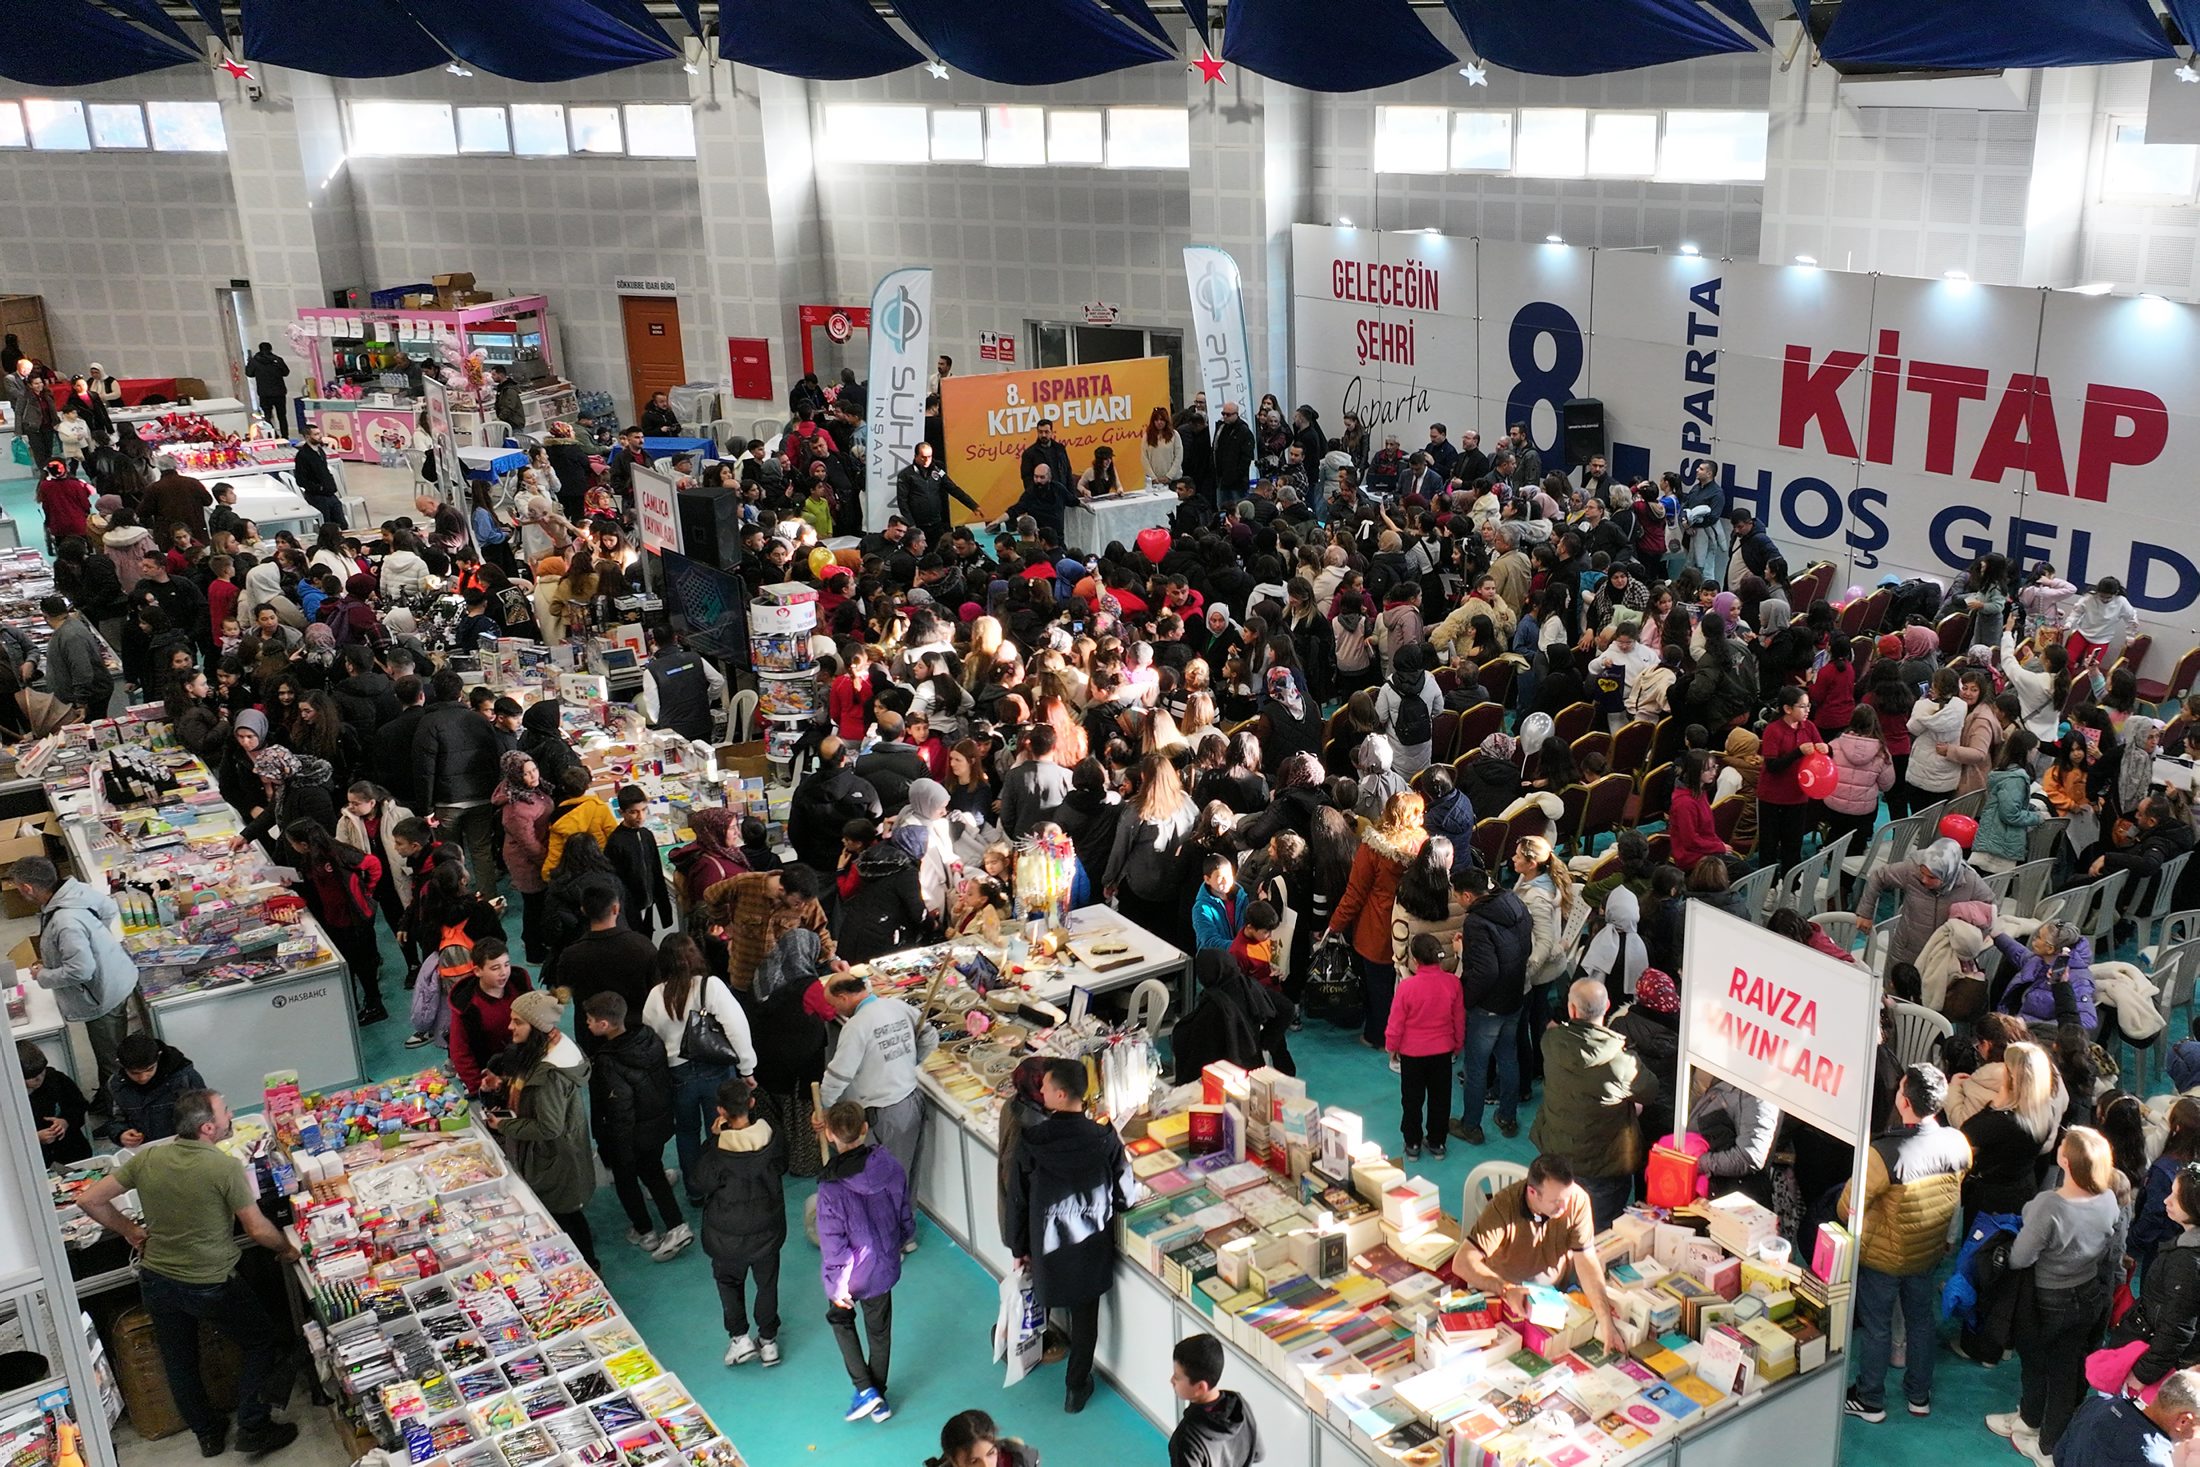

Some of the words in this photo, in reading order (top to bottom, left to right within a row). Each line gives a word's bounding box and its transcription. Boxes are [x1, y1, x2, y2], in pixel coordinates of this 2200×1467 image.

[645, 280, 660, 290] İDARİ
[660, 282, 675, 291] BÜRO
[1332, 258, 1439, 311] GELECEĞİN
[1356, 318, 1415, 366] ŞEHRİ
[1006, 383, 1026, 407] 8.
[1032, 374, 1113, 403] ISPARTA
[1680, 277, 1723, 487] SPARTA
[870, 397, 886, 479] İNŞAAT
[987, 403, 1061, 437] KİTAP
[1063, 394, 1133, 428] FUARI
[1778, 328, 2169, 503] KİTAP
[643, 491, 670, 519] ÇAMLICA
[643, 514, 675, 545] YAYINLARI
[1720, 463, 1889, 570] HOŞ
[1728, 966, 1818, 1037] RAVZA
